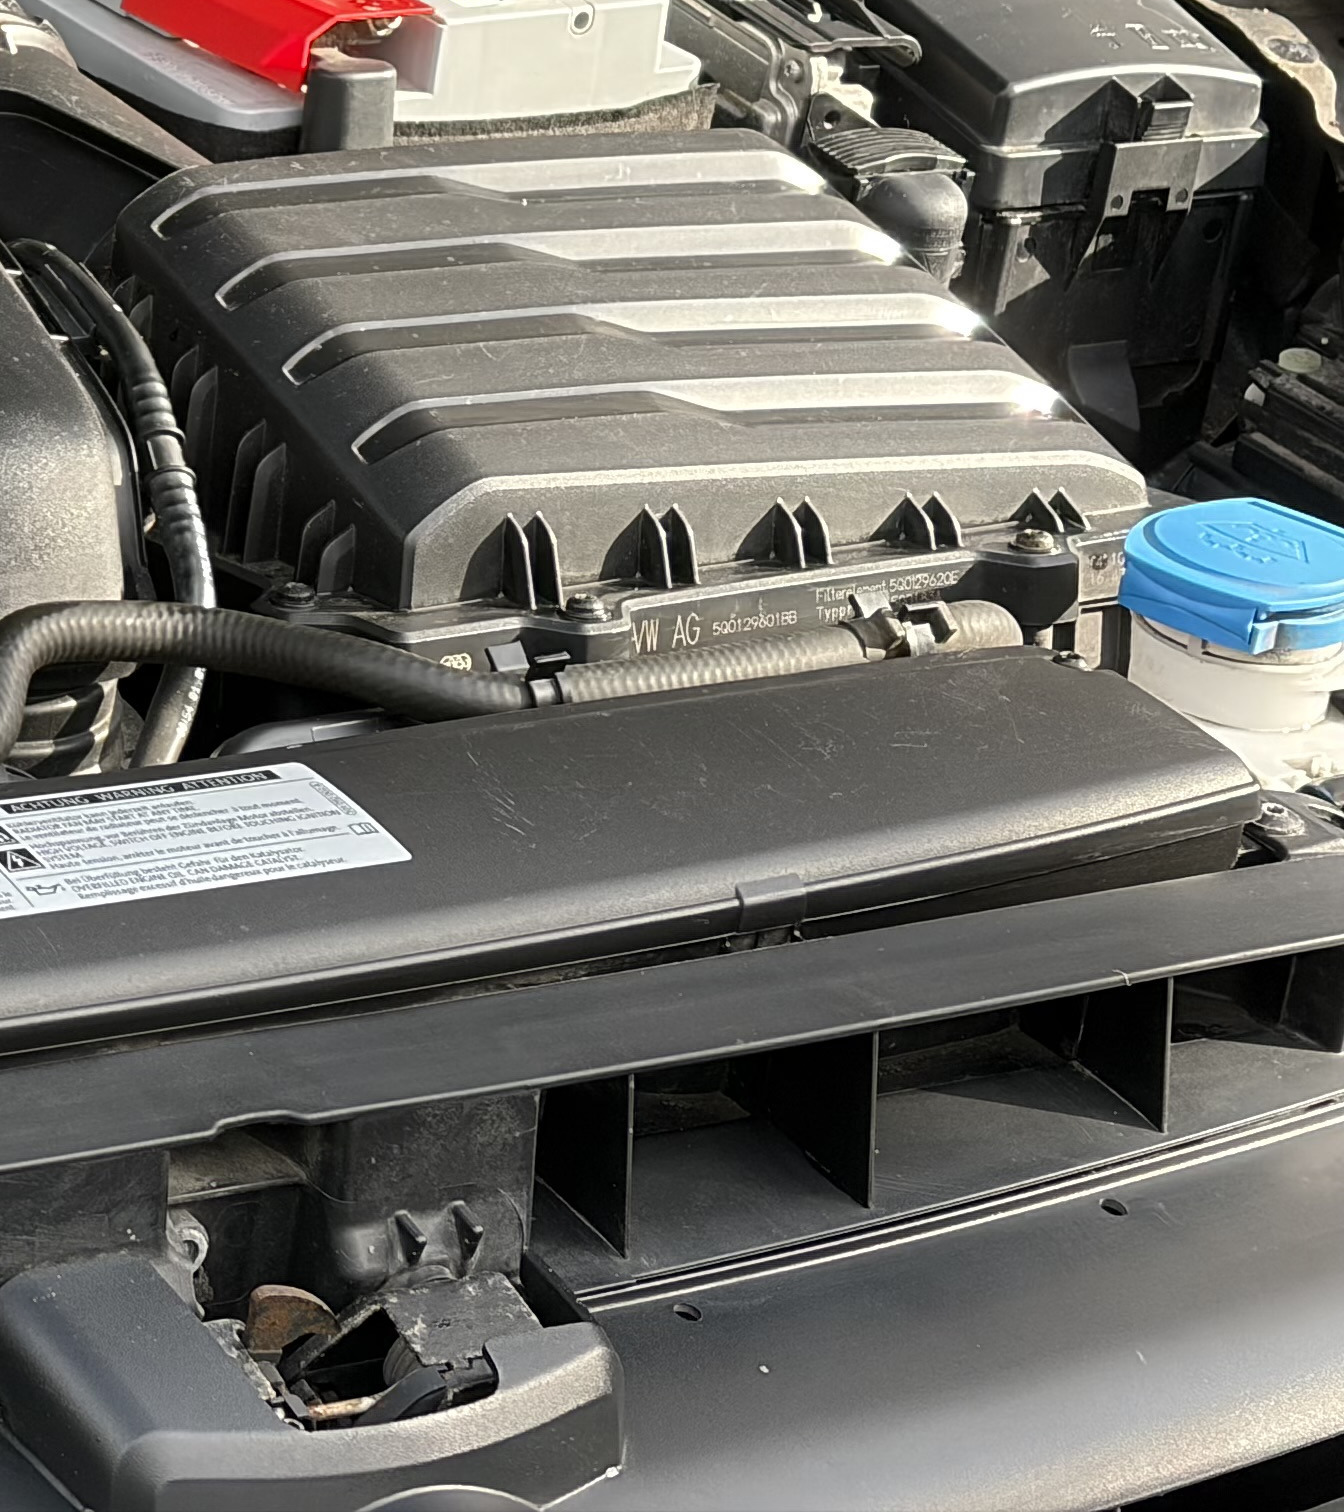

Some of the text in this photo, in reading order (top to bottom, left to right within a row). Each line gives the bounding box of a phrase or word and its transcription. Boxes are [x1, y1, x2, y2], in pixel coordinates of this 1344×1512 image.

[632, 619, 659, 654] VW
[672, 612, 703, 648] AG
[7, 771, 270, 813] ACHTUNG WARNING ATTENTION
